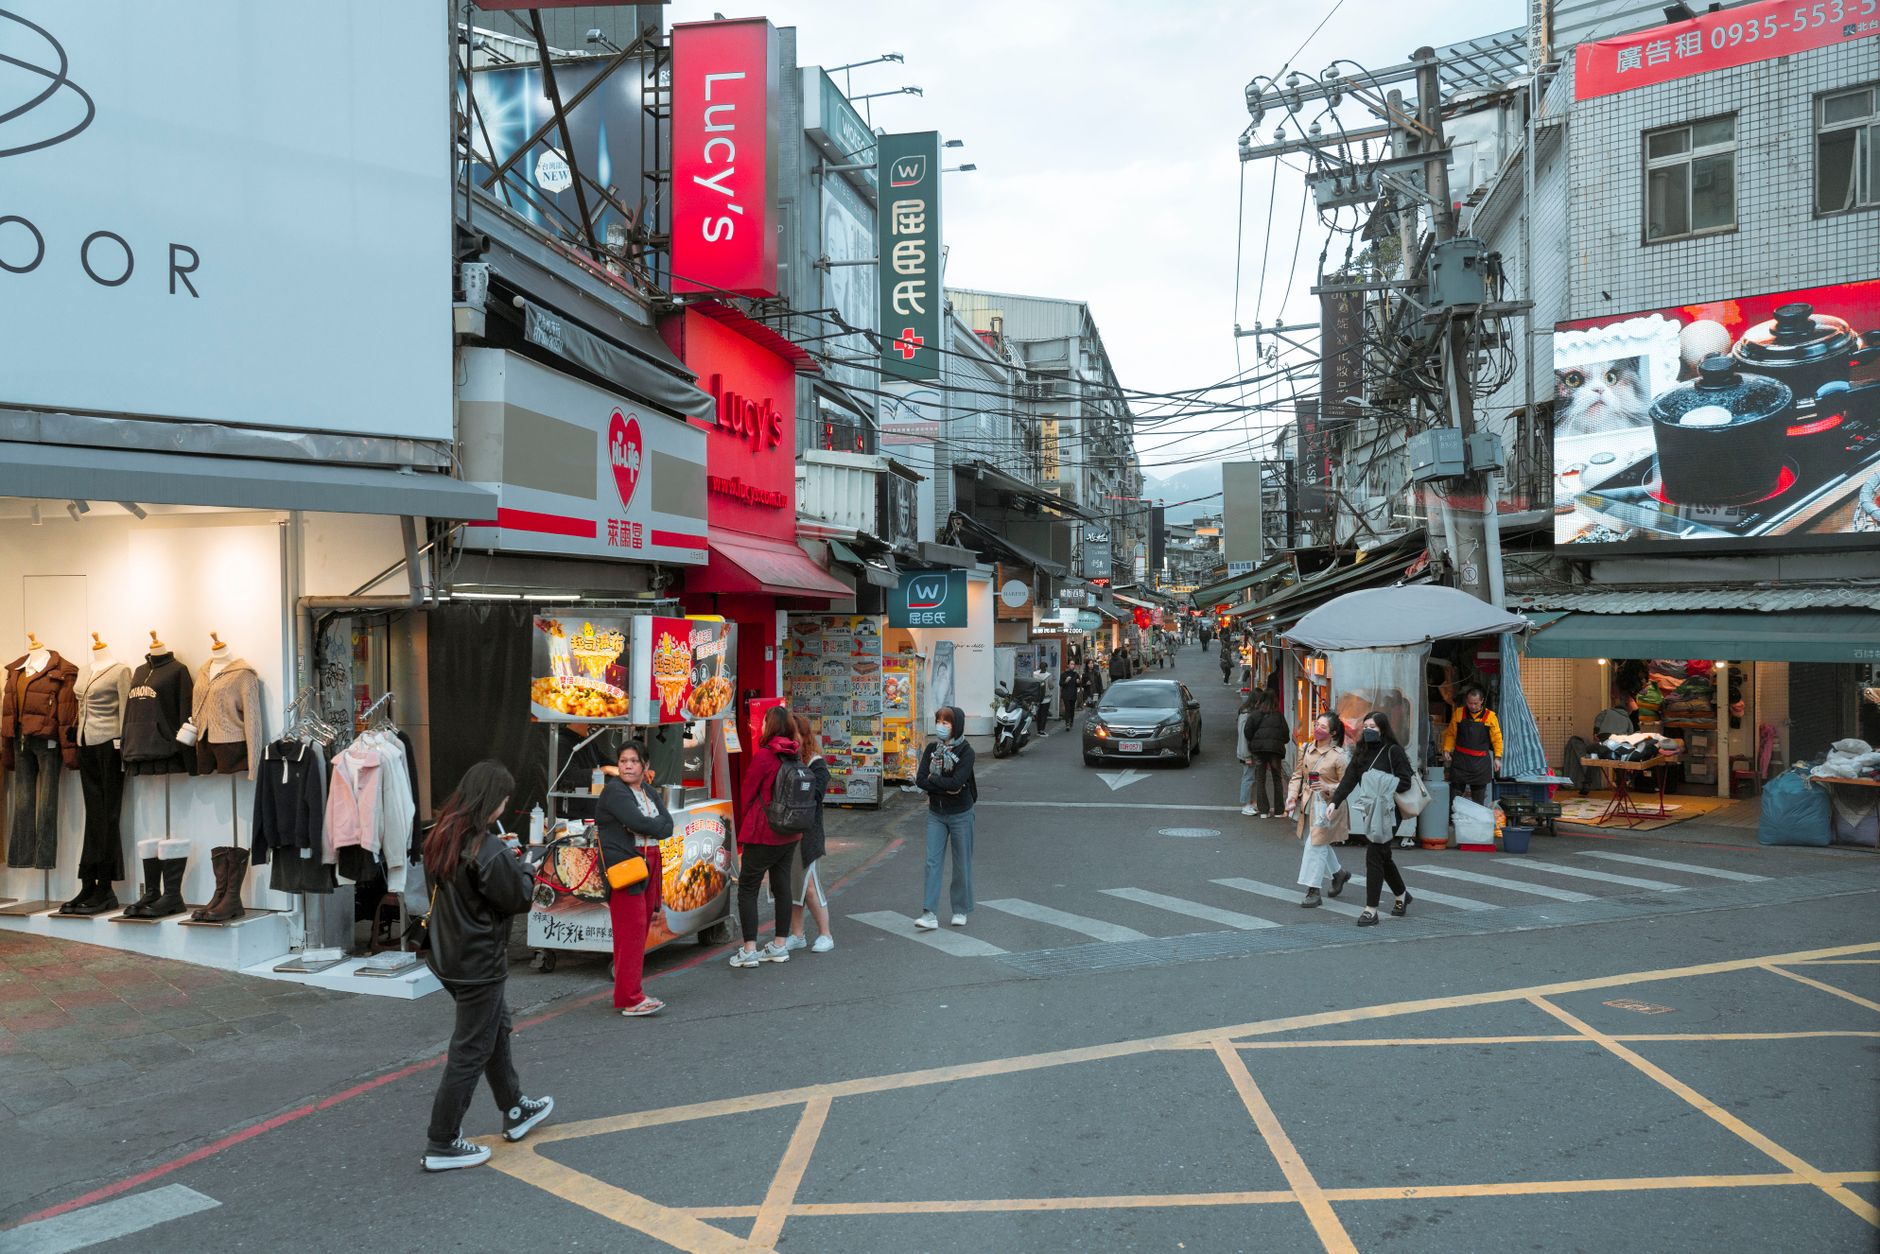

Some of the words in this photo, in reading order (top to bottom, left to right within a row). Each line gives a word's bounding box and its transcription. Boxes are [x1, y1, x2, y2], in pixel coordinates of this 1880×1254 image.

[1616, 31, 1703, 74] 廣告租
[543, 170, 569, 182] NEW
[694, 72, 746, 242] Lucy's
[0, 215, 200, 299] OOR
[892, 199, 926, 316] 屈臣氏
[709, 373, 783, 454] Lucy's
[612, 431, 639, 484] Hi-Life
[608, 517, 643, 550] 萊爾富
[909, 612, 946, 625] 屈臣氏
